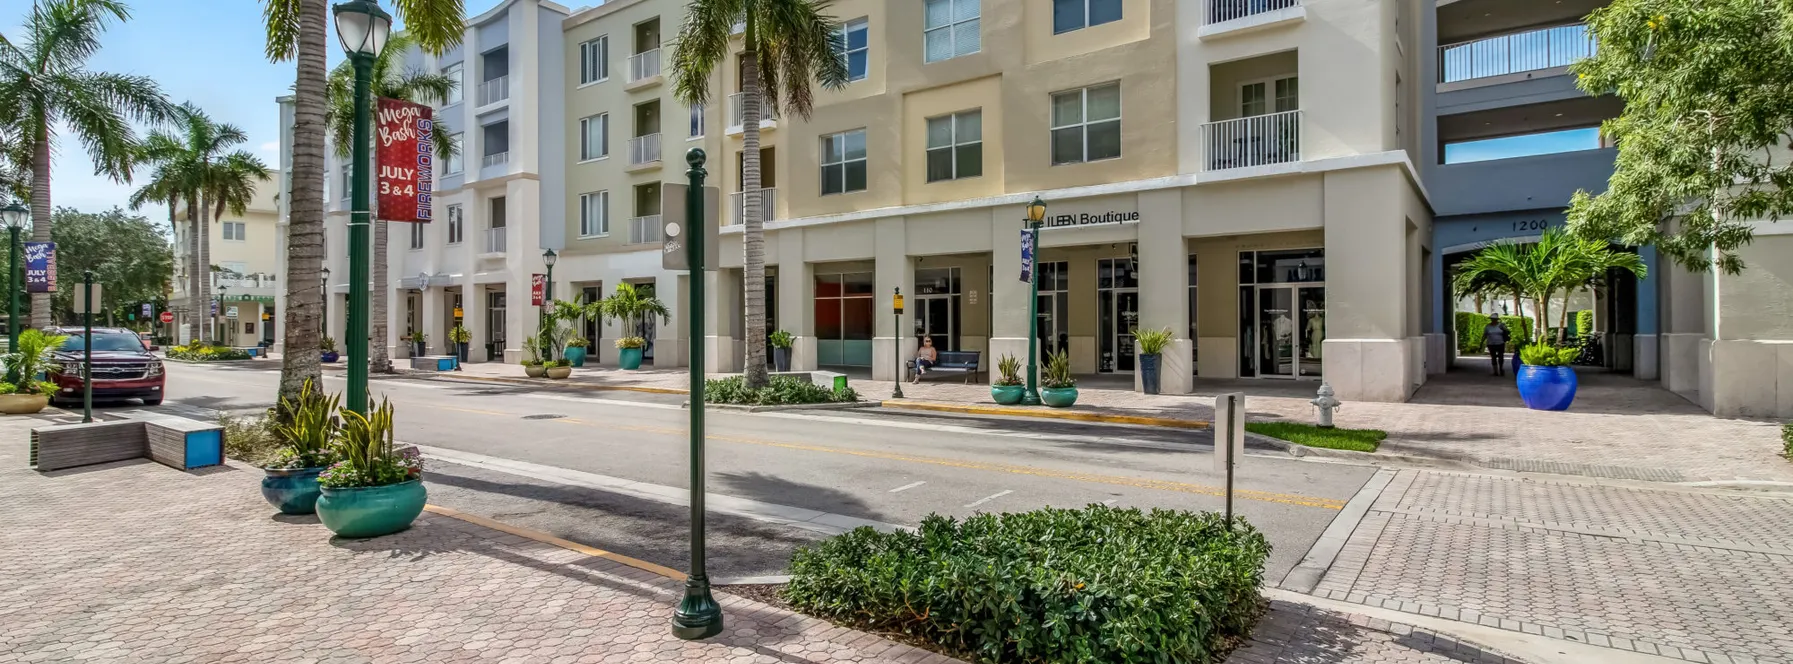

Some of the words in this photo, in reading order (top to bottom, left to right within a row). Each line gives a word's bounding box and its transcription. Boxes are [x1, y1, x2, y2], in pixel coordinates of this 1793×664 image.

[379, 107, 420, 125] Mega
[379, 120, 416, 147] Bash
[379, 165, 414, 180] JULY
[417, 118, 433, 219] FIREWORKS
[380, 181, 391, 195] 3
[392, 186, 402, 196] &
[403, 184, 414, 197] 4
[1080, 211, 1139, 224] Boutique
[1512, 219, 1548, 232] 1200
